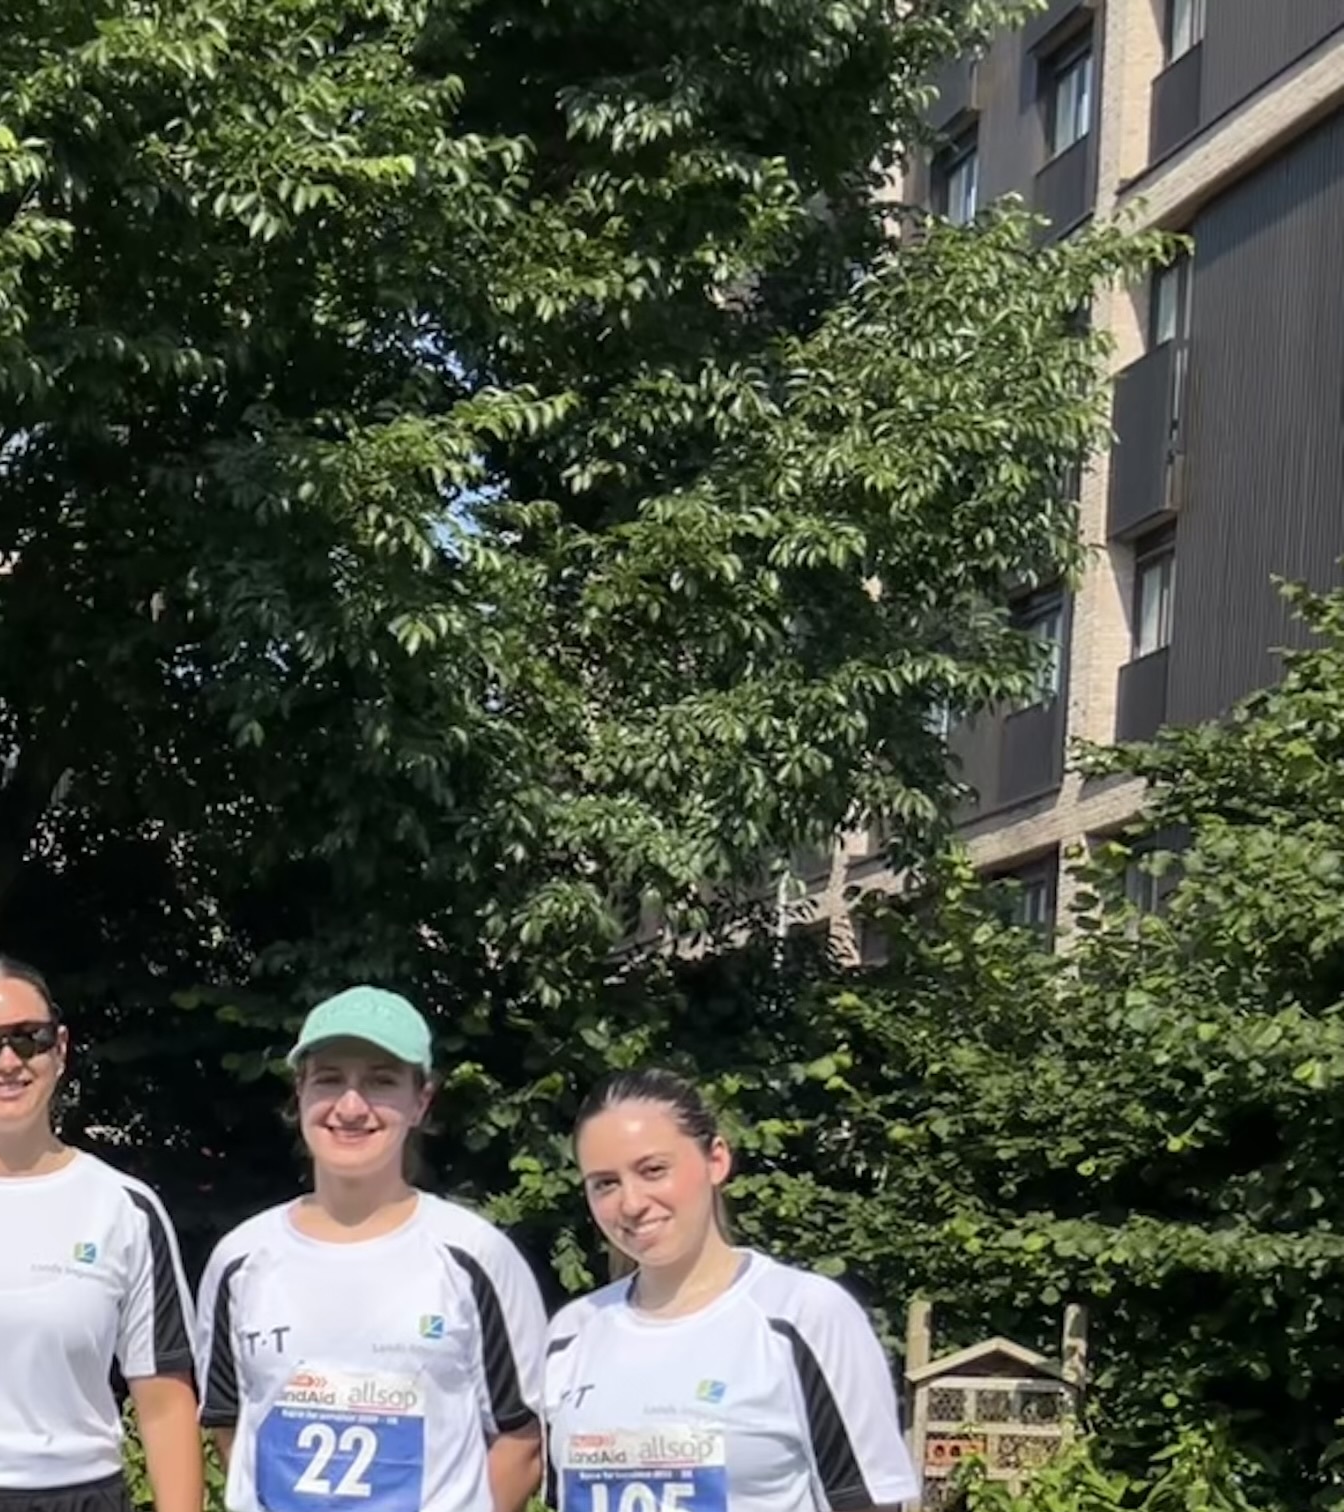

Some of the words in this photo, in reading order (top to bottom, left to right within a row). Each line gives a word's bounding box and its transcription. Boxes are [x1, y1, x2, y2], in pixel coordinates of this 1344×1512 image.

[348, 1382, 418, 1410] allsop
[293, 1422, 379, 1498] 22
[639, 1436, 713, 1464] allsop
